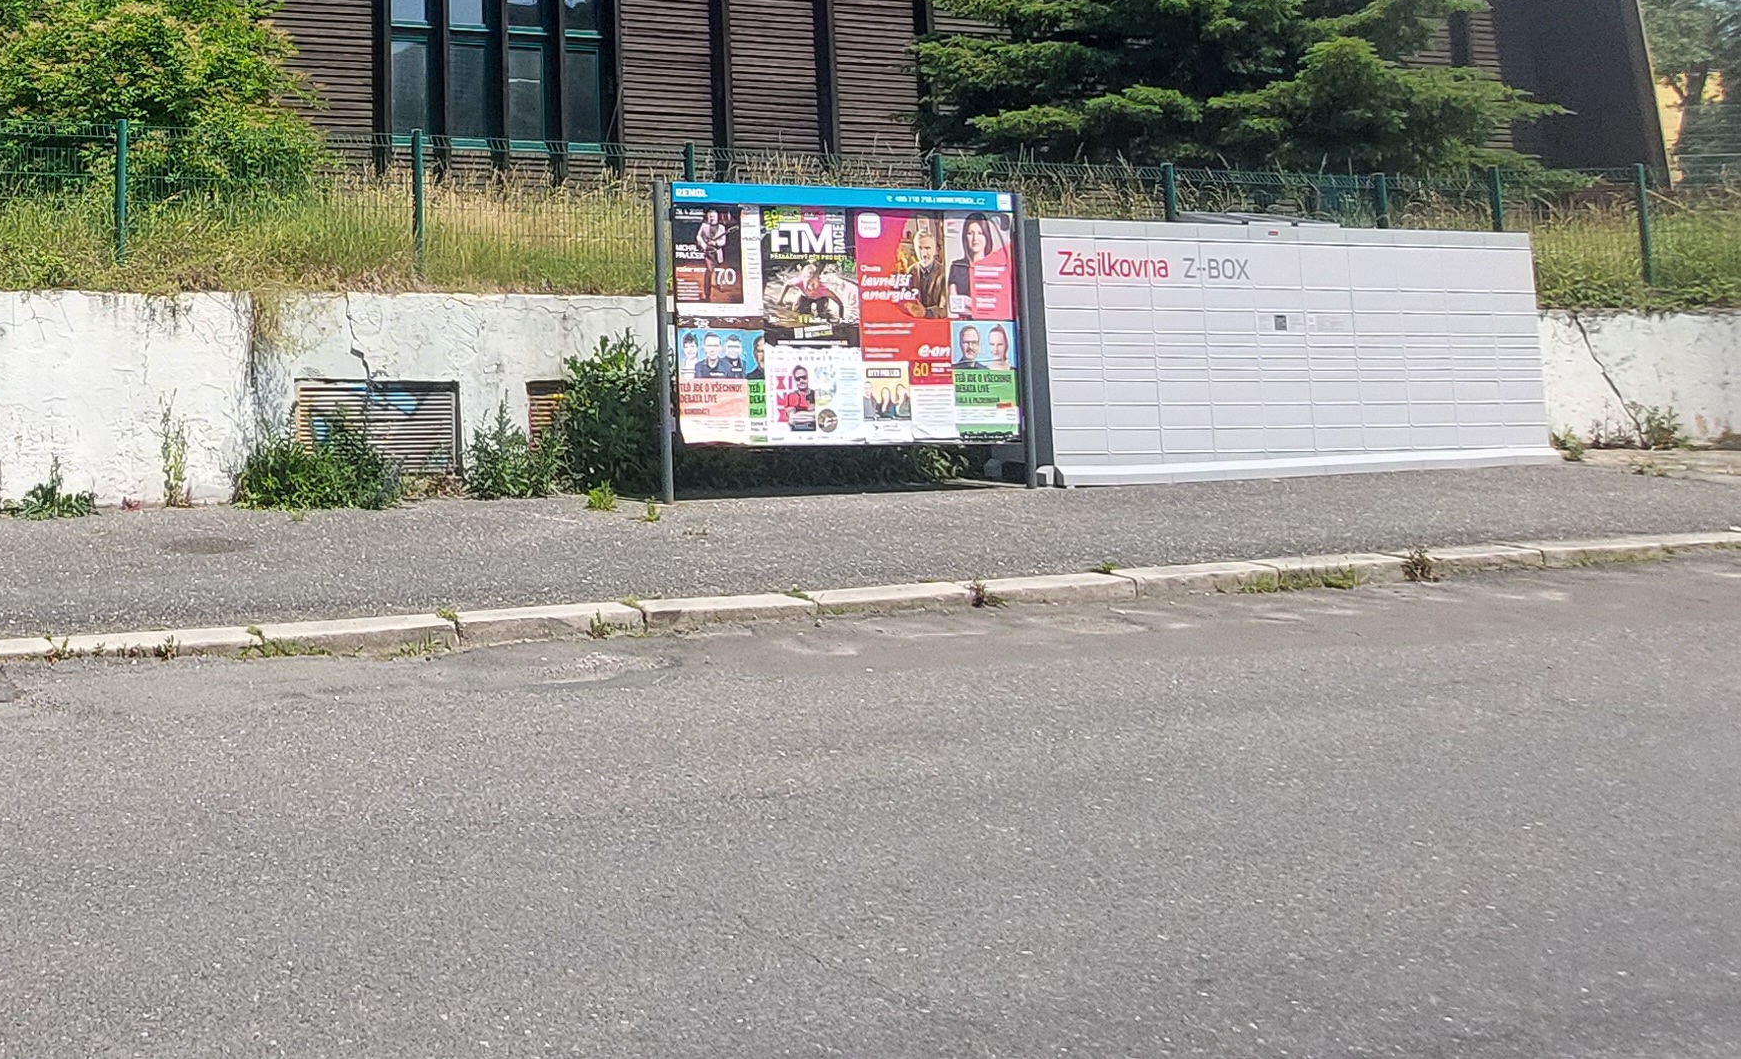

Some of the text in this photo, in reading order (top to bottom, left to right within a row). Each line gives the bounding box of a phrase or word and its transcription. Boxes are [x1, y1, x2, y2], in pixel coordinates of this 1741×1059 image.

[675, 187, 708, 198] RENGL
[764, 209, 779, 221] 20
[765, 220, 780, 230] 25
[771, 223, 833, 254] FTM
[832, 223, 847, 254] RACE
[1057, 250, 1250, 280] Zásilkovna Z-BOX
[861, 274, 911, 288] levnější
[862, 288, 919, 302] energie?
[967, 373, 977, 383] JDE
[693, 382, 704, 392] JDE
[704, 383, 710, 392] O
[978, 384, 990, 394] LIVE
[679, 394, 718, 404] DEBATA LIVE
